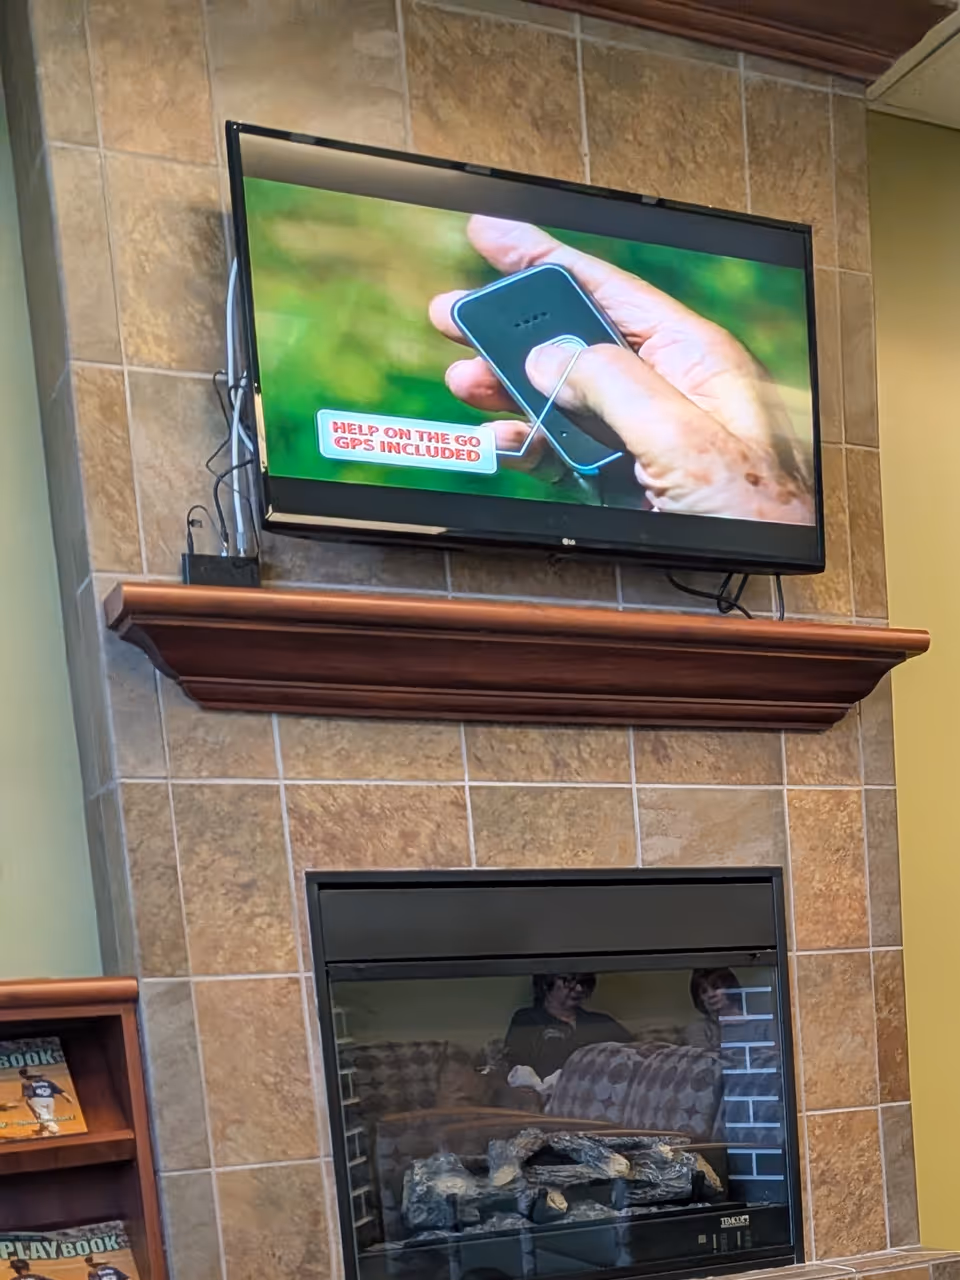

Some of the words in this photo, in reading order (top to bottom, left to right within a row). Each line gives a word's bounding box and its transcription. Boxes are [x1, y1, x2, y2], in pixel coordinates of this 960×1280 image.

[332, 421, 379, 437] HELP
[384, 427, 411, 441] ON
[416, 430, 451, 445] THE
[454, 434, 481, 448] GO
[334, 436, 375, 451] GPS
[380, 440, 481, 462] INCLUDED
